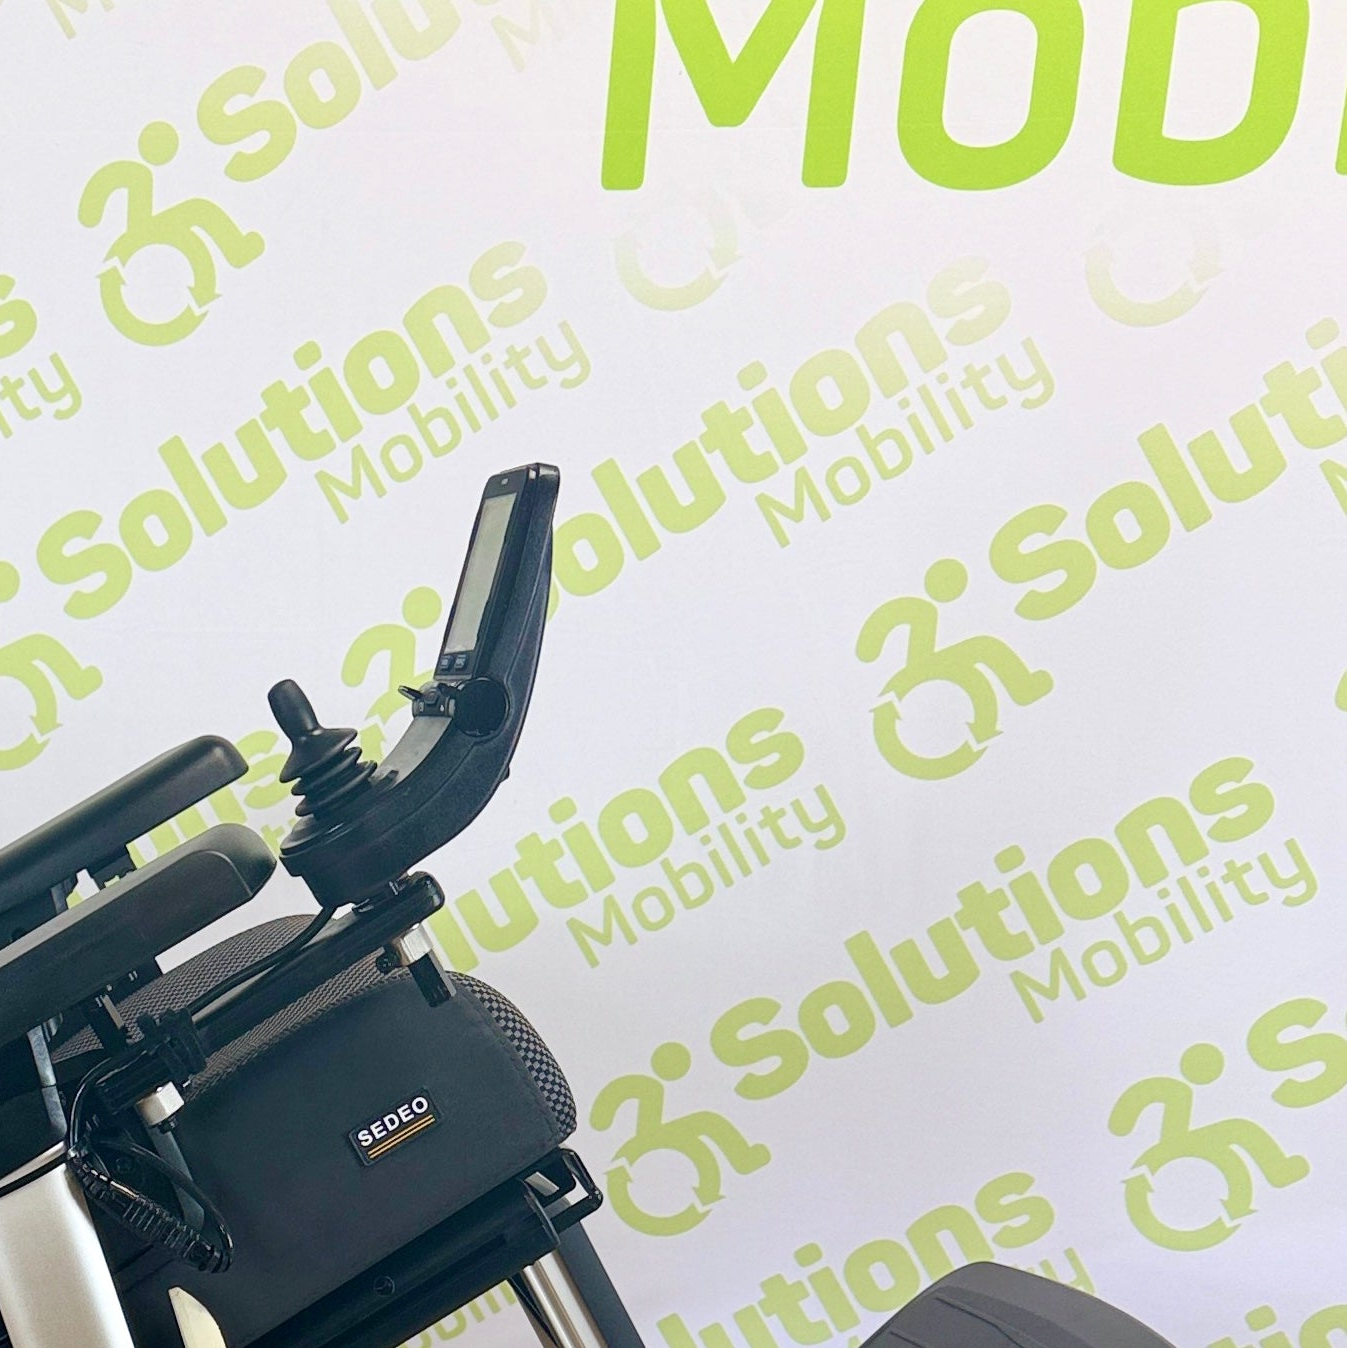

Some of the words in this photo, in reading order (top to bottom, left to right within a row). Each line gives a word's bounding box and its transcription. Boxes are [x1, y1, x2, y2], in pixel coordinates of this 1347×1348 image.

[37, 242, 547, 620] Solutions
[315, 321, 592, 525] Mobility
[548, 254, 1013, 621] olutions
[755, 337, 1055, 548] Mobility
[566, 784, 847, 969] Mobility
[711, 756, 1275, 1101] Solutions
[1010, 838, 1319, 1023] Mobility
[358, 1097, 428, 1147] SEDEO
